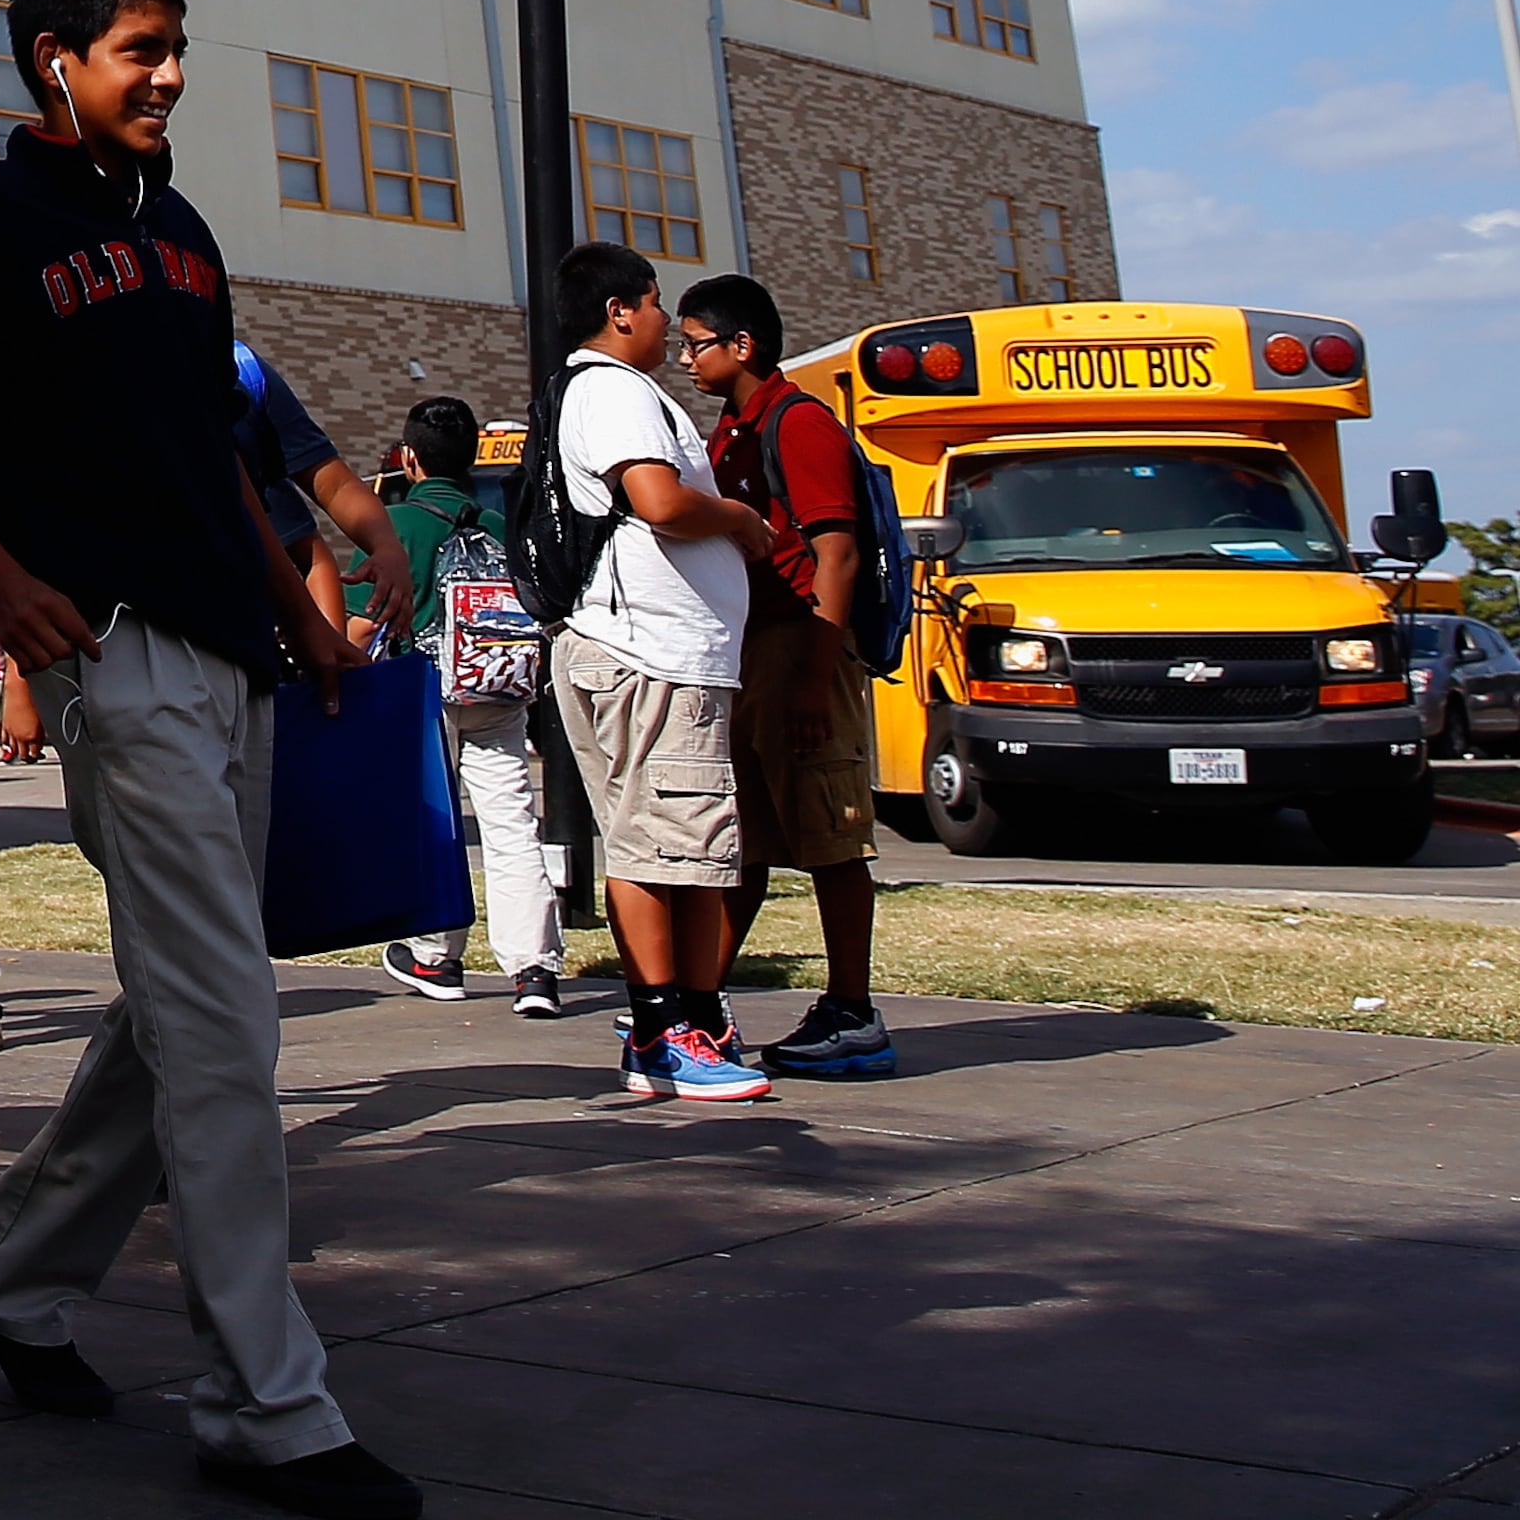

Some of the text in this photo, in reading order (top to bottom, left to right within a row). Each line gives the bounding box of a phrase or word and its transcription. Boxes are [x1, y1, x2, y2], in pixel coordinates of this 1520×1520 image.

[42, 240, 145, 318] OLD
[1013, 346, 1212, 391] SCHOOL BUS
[491, 440, 526, 460] BUS
